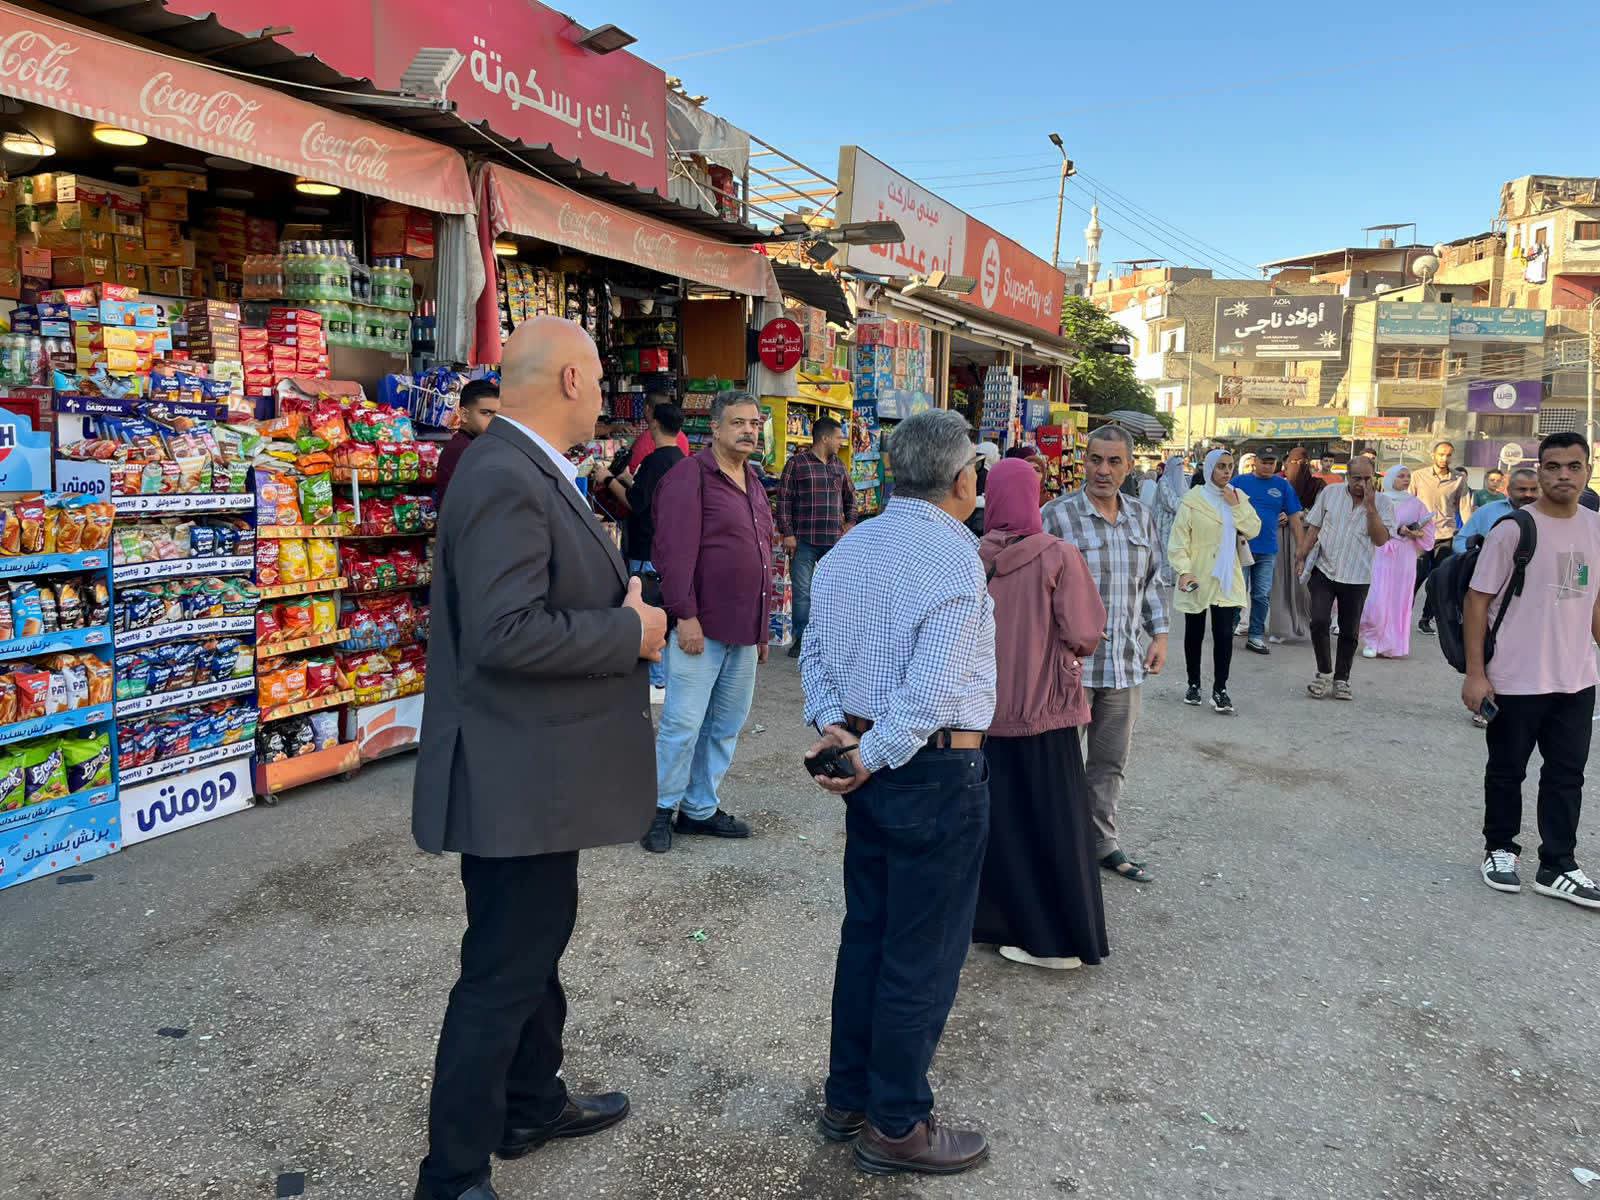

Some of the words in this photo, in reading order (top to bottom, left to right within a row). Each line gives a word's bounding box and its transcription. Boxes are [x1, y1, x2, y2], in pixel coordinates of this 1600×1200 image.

[469, 35, 583, 139] بسكوتة
[587, 103, 654, 158] كشك
[888, 182, 916, 213] ماركت
[1285, 302, 1325, 328] أولاد
[86, 404, 105, 412] DAIRY
[174, 407, 192, 415] DAIRY
[72, 828, 109, 848] برنش
[23, 839, 71, 862] يسندك
